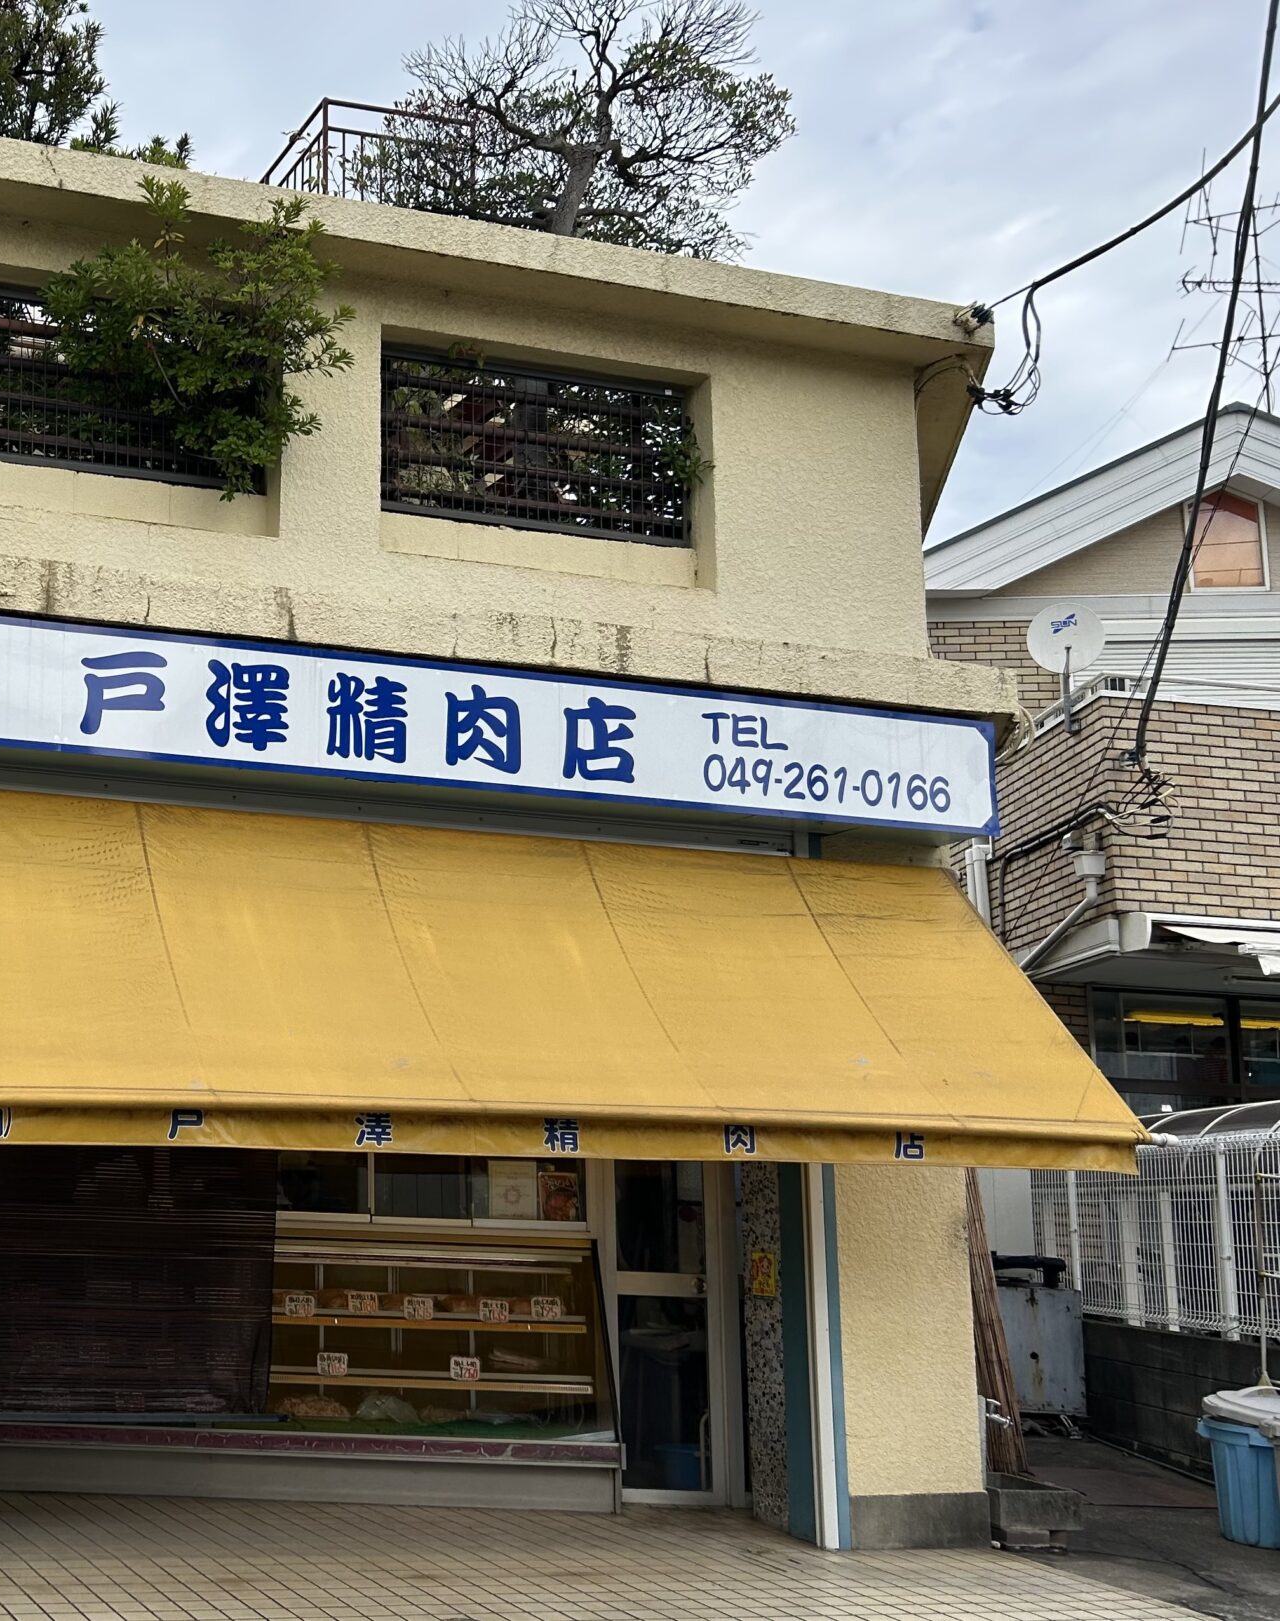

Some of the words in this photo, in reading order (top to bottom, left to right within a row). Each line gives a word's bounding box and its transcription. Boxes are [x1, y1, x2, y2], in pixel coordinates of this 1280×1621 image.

[80, 650, 636, 785] 戸澤精肉店
[702, 711, 789, 751] TEL
[703, 753, 951, 813] 049-261-0166
